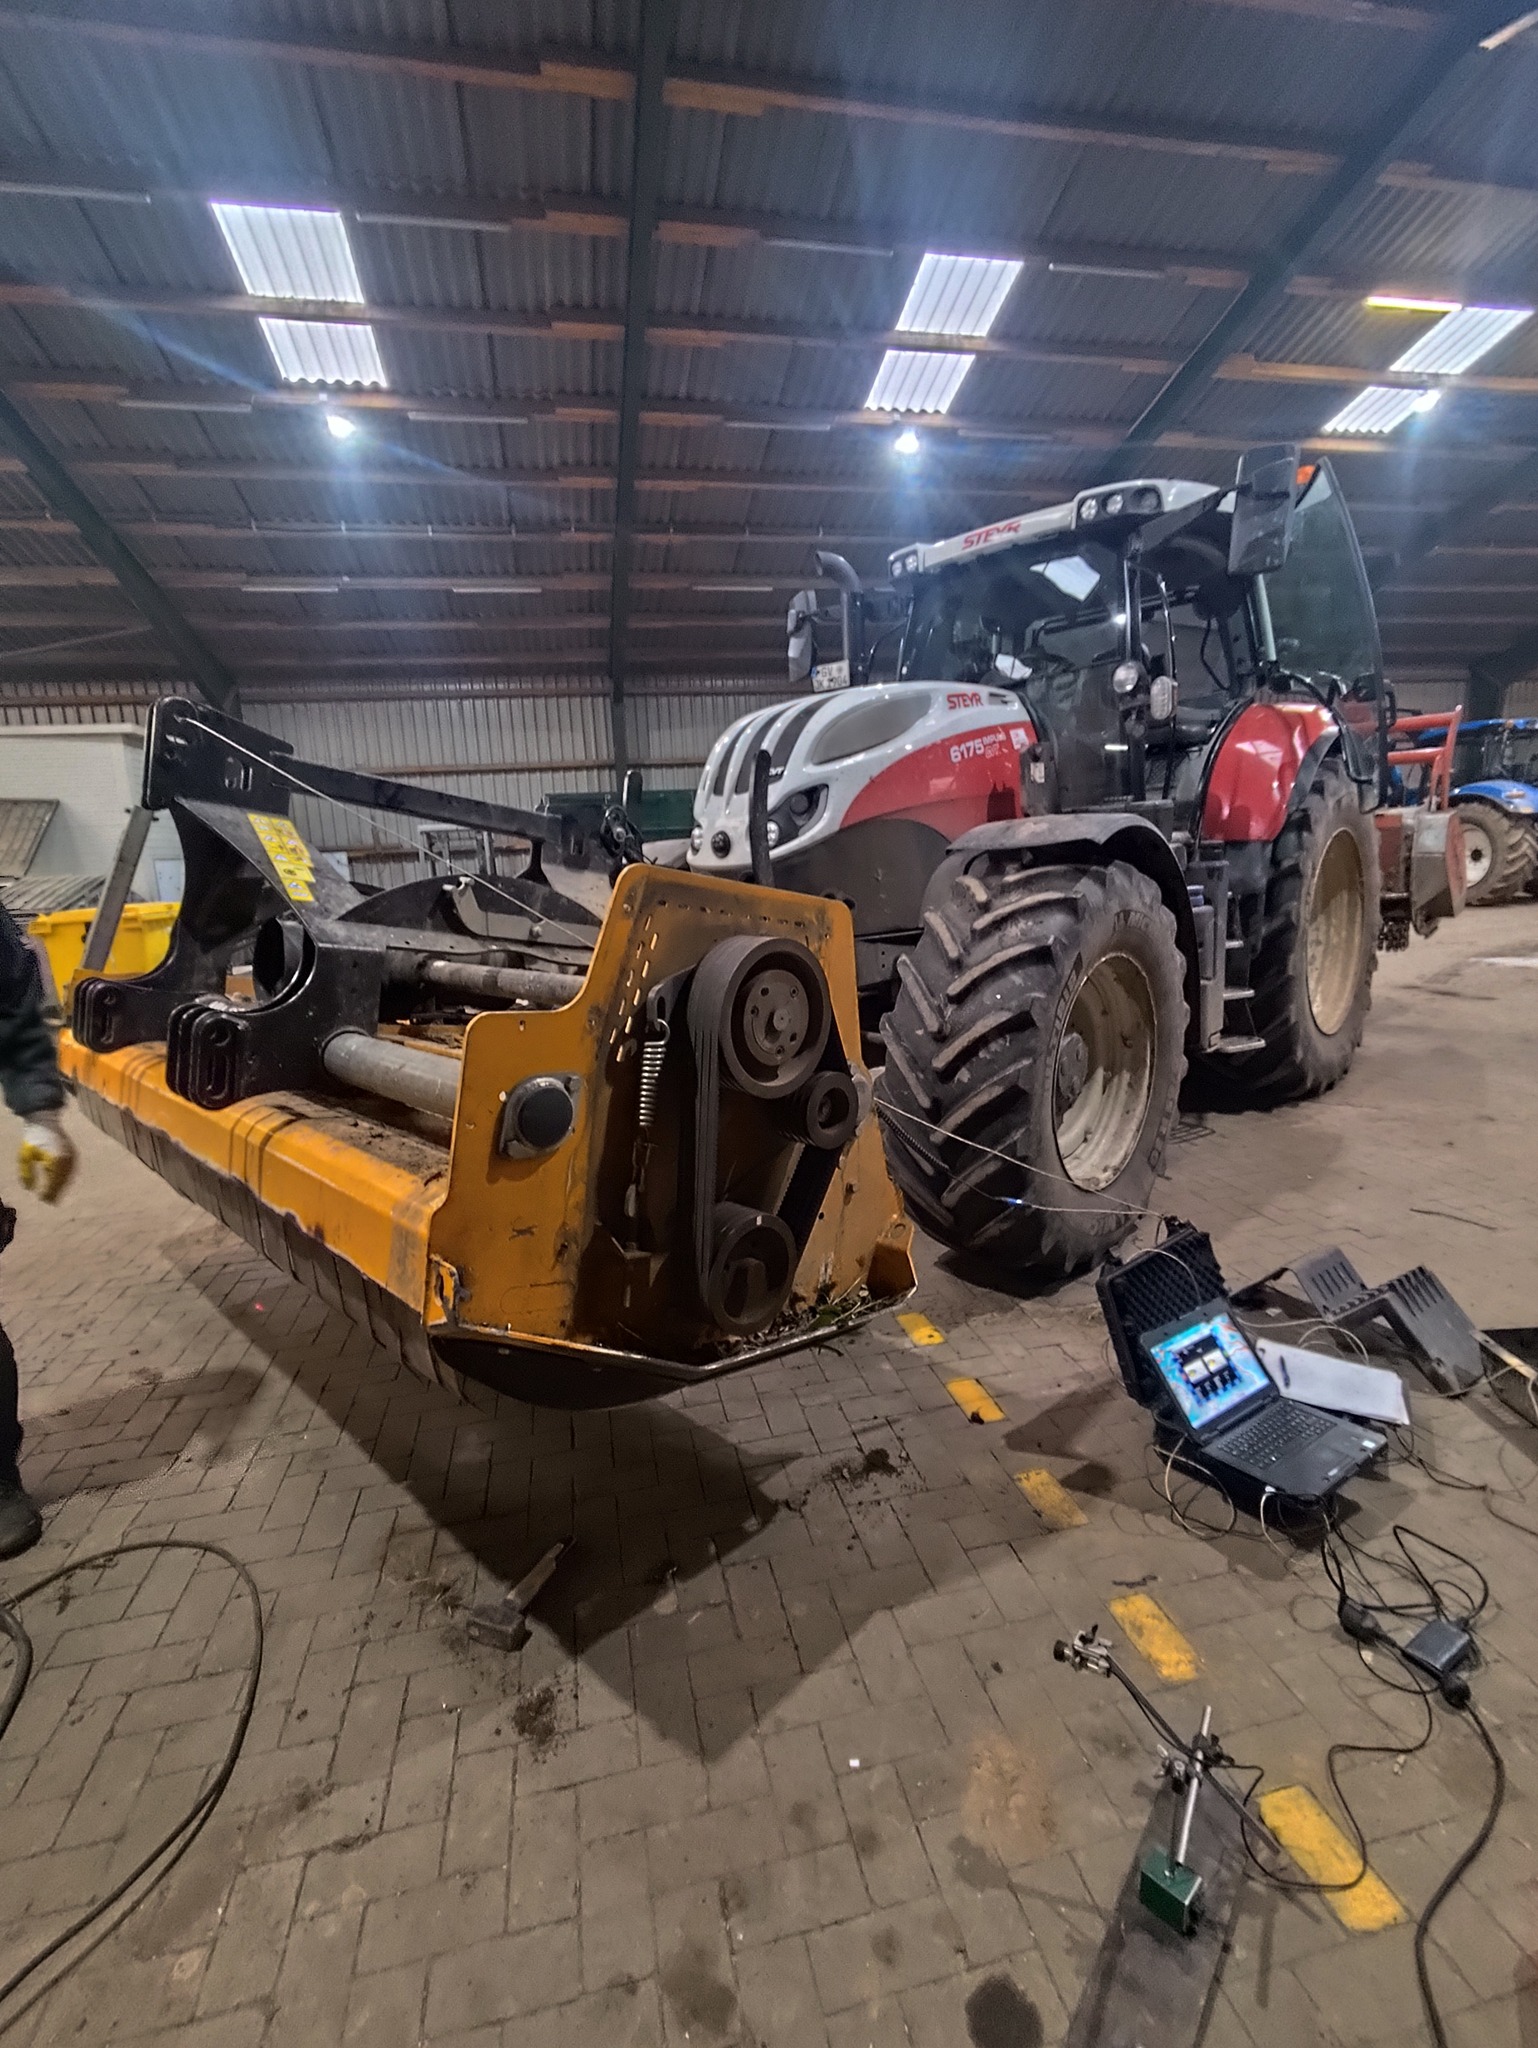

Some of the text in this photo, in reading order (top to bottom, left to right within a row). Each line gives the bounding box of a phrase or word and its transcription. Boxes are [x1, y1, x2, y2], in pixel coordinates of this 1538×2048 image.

[961, 520, 1021, 550] STEYR
[821, 665, 833, 677] GV
[947, 692, 983, 710] STEYR
[950, 738, 984, 763] 6175
